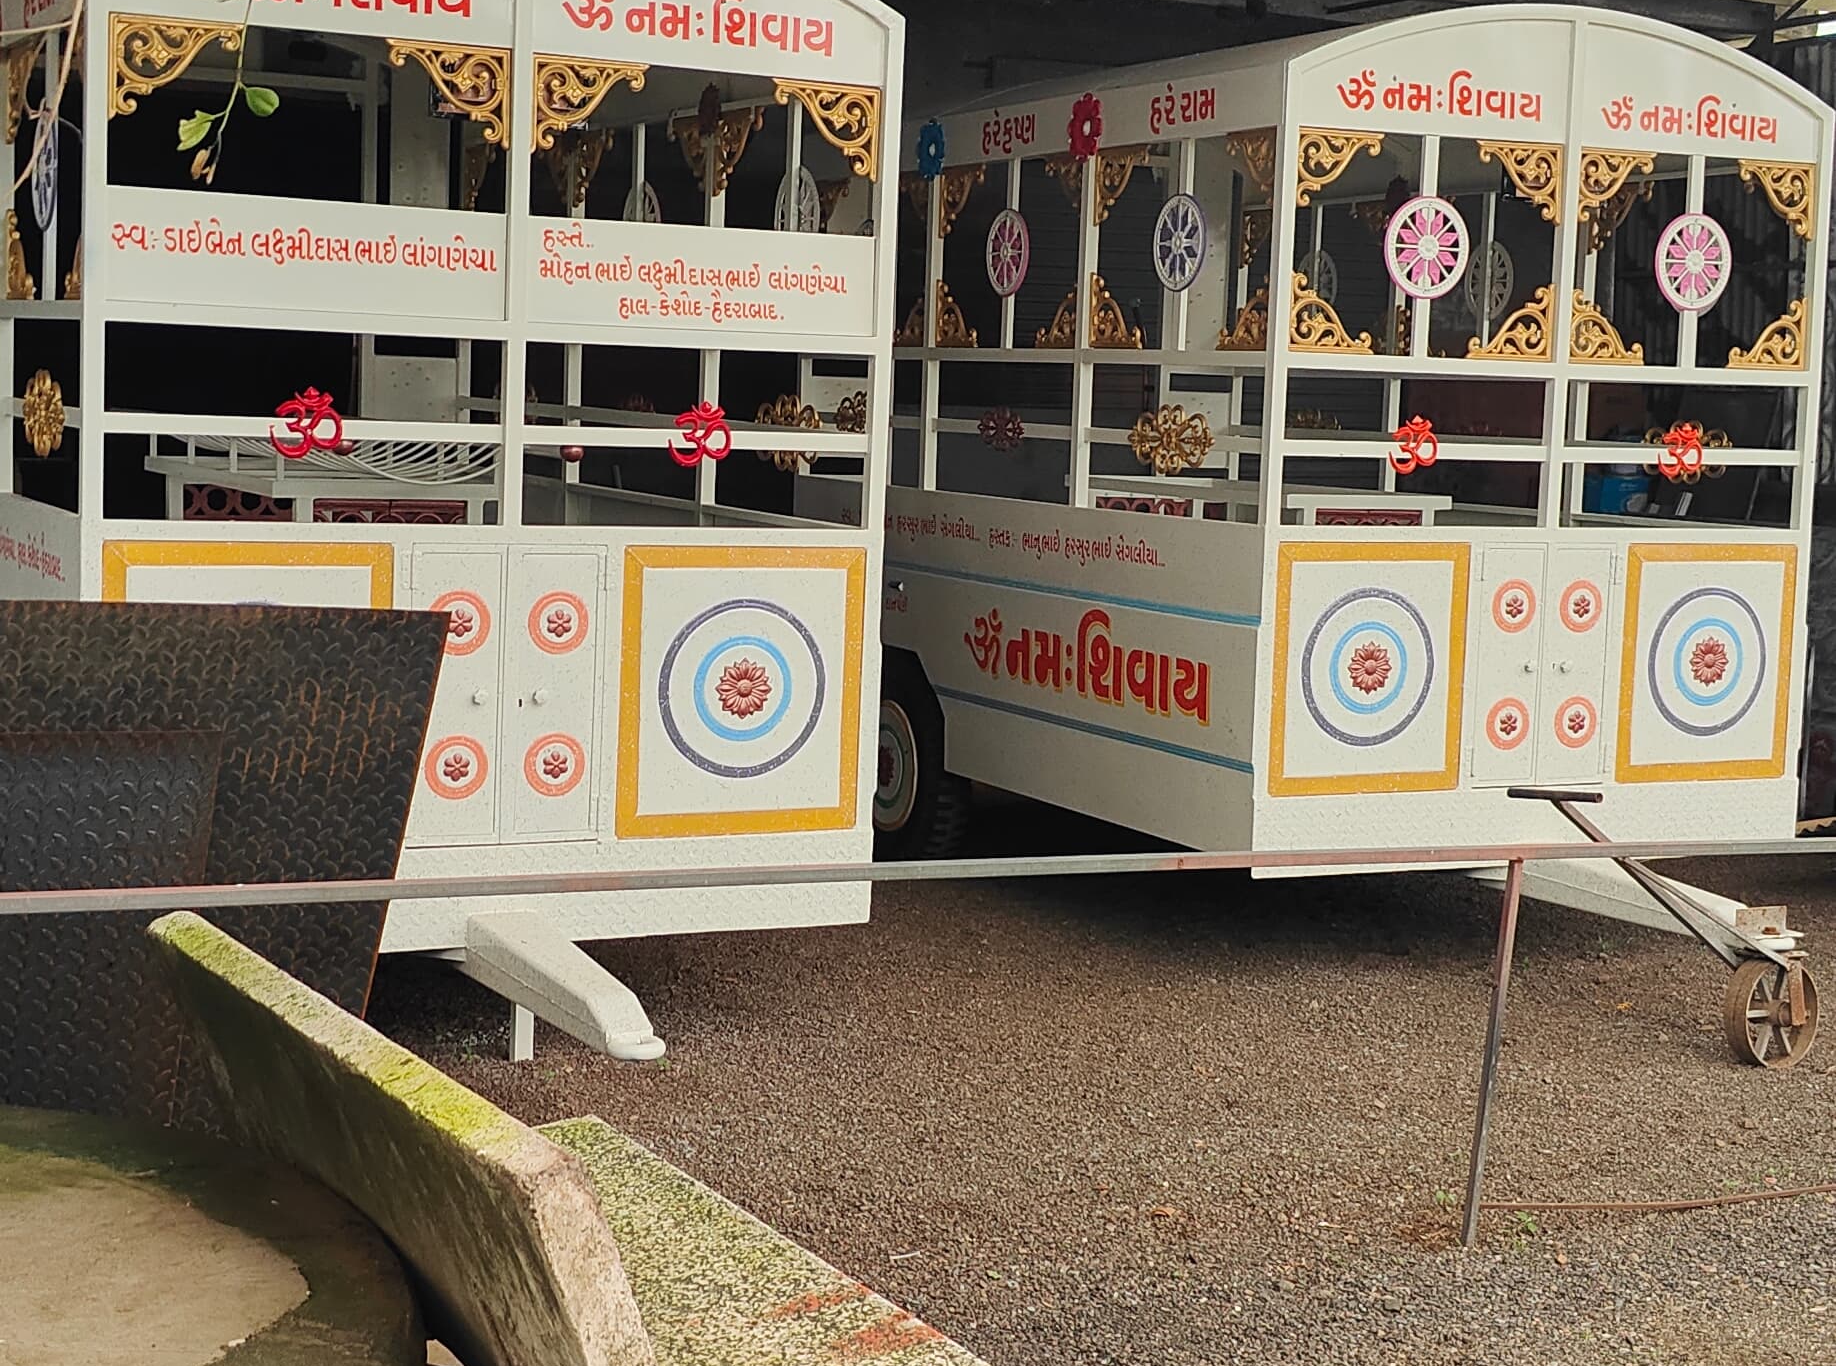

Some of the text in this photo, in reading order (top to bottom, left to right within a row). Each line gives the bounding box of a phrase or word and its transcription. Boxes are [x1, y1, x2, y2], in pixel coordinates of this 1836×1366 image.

[1448, 70, 1541, 122] શિવાય
[1696, 95, 1777, 143] શિવાય
[1077, 608, 1211, 727] શિવાય
